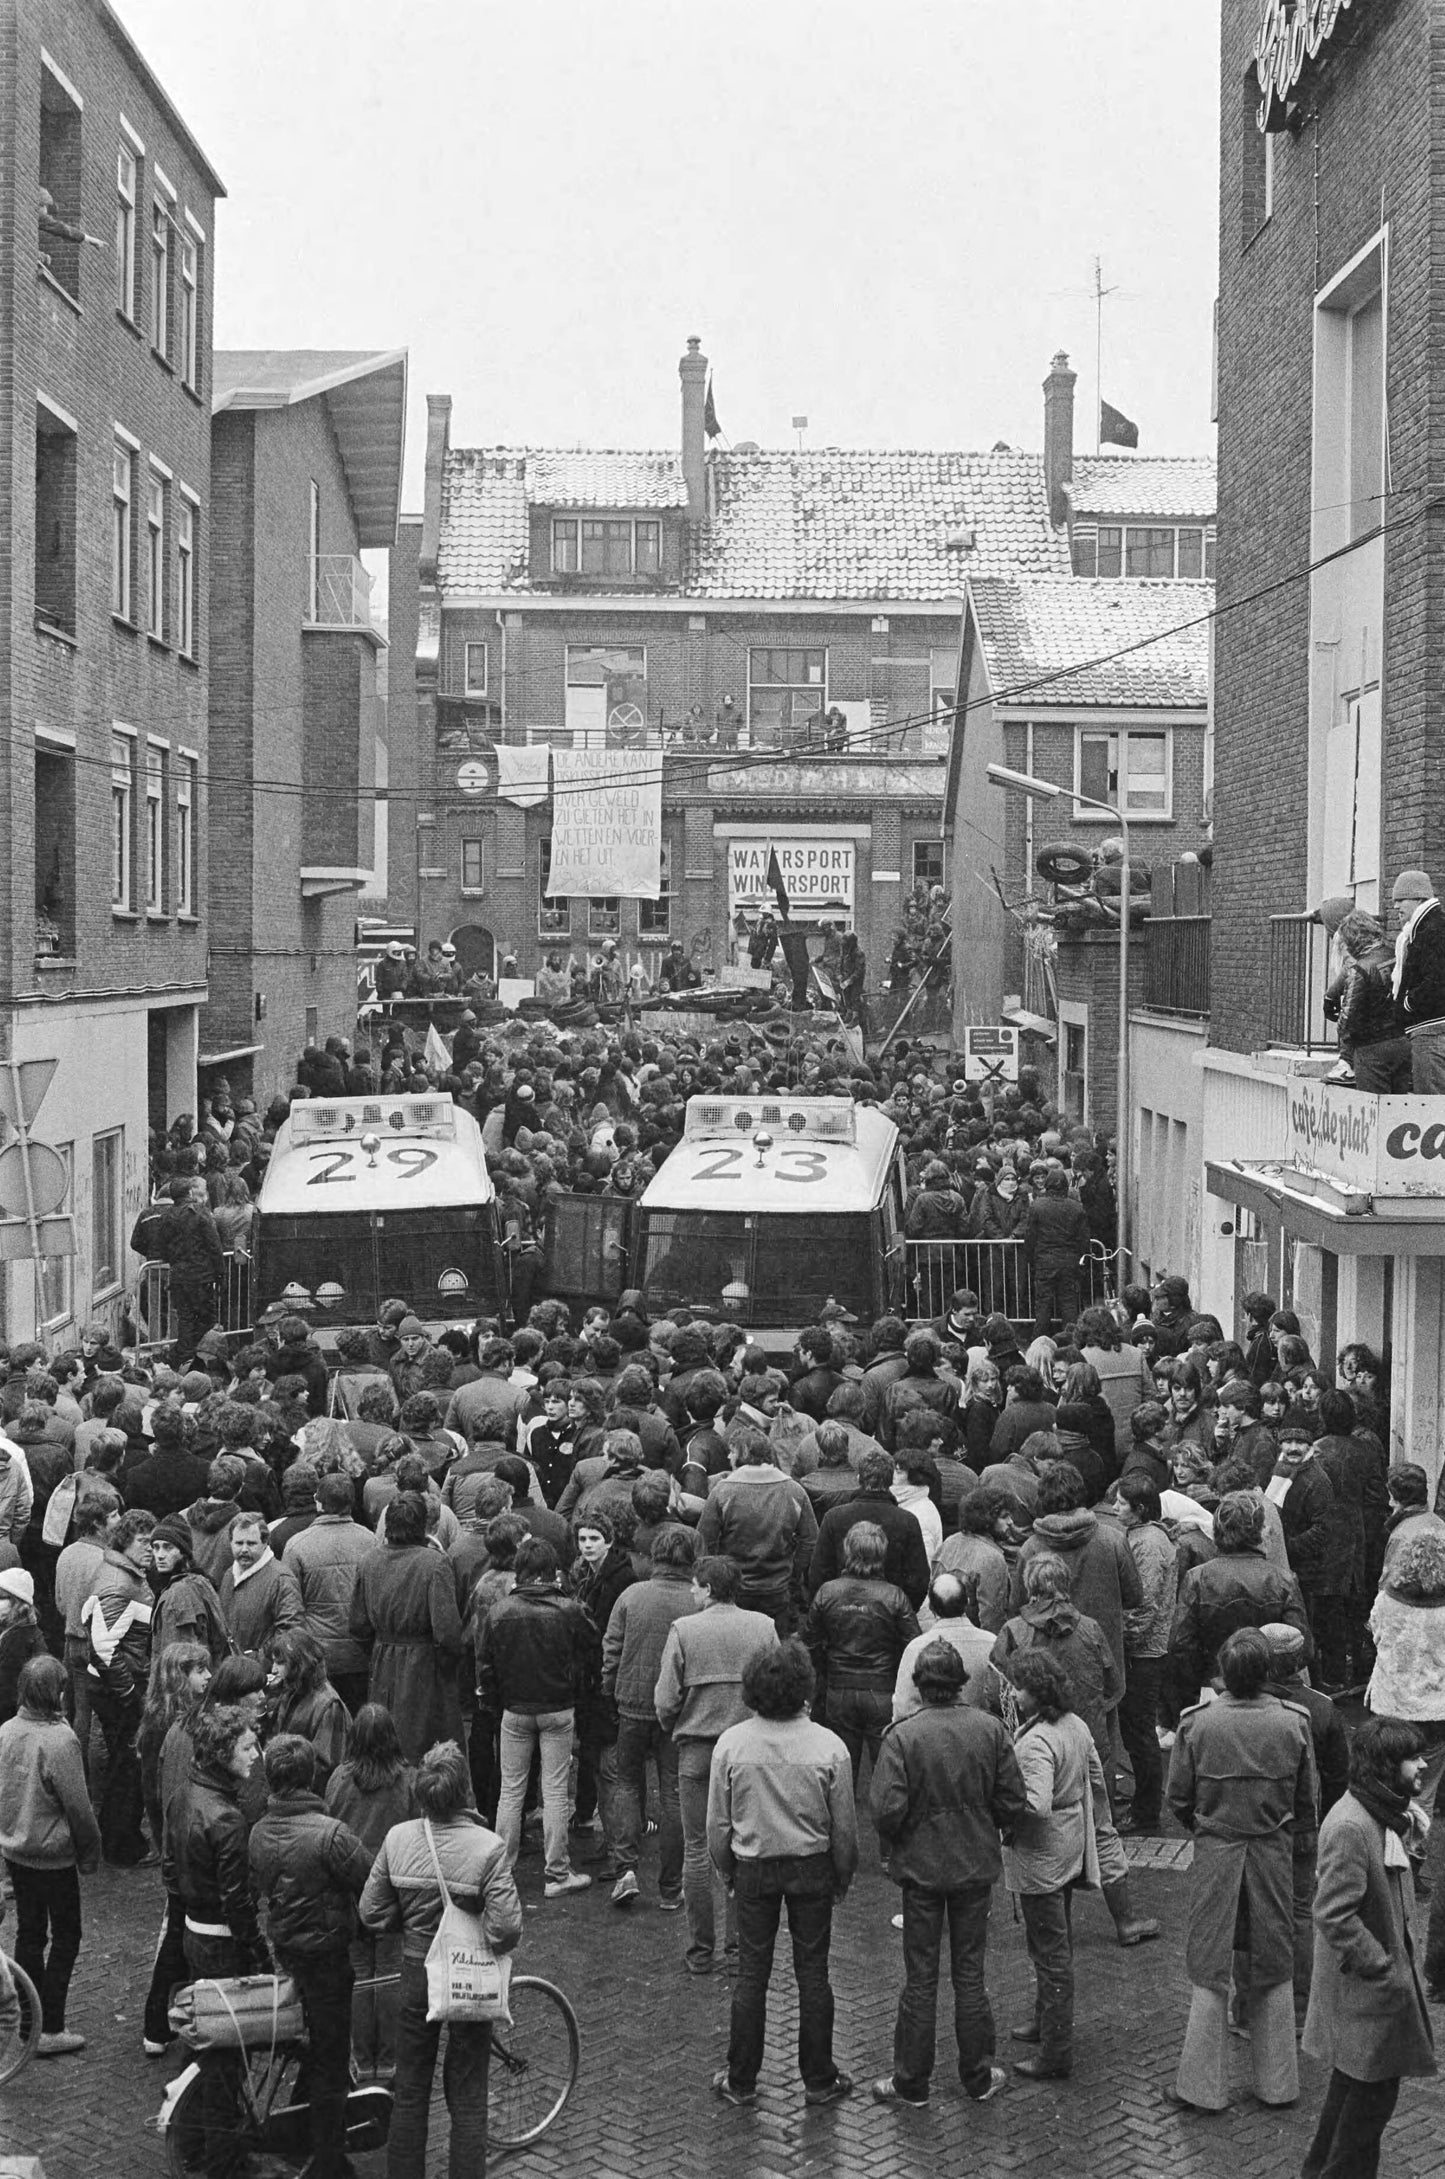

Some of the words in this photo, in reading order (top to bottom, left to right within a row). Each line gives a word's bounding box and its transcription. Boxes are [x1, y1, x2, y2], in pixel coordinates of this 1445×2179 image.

[556, 752, 571, 769] DE
[574, 752, 620, 769] ANDERE
[622, 752, 654, 769] KANT
[556, 790, 586, 808] OVER
[588, 789, 640, 808] GEWELD
[573, 808, 614, 826] GIETEN
[617, 808, 637, 826] HET
[642, 809, 655, 828] IN
[554, 827, 604, 847] WETTEN
[605, 827, 622, 847] EN
[554, 847, 569, 866] EN
[572, 847, 591, 866] HET
[733, 849, 852, 869] WATRSPORT
[733, 874, 851, 894] WINRSPORT
[306, 1148, 438, 1185] 29
[691, 1148, 828, 1183] 23
